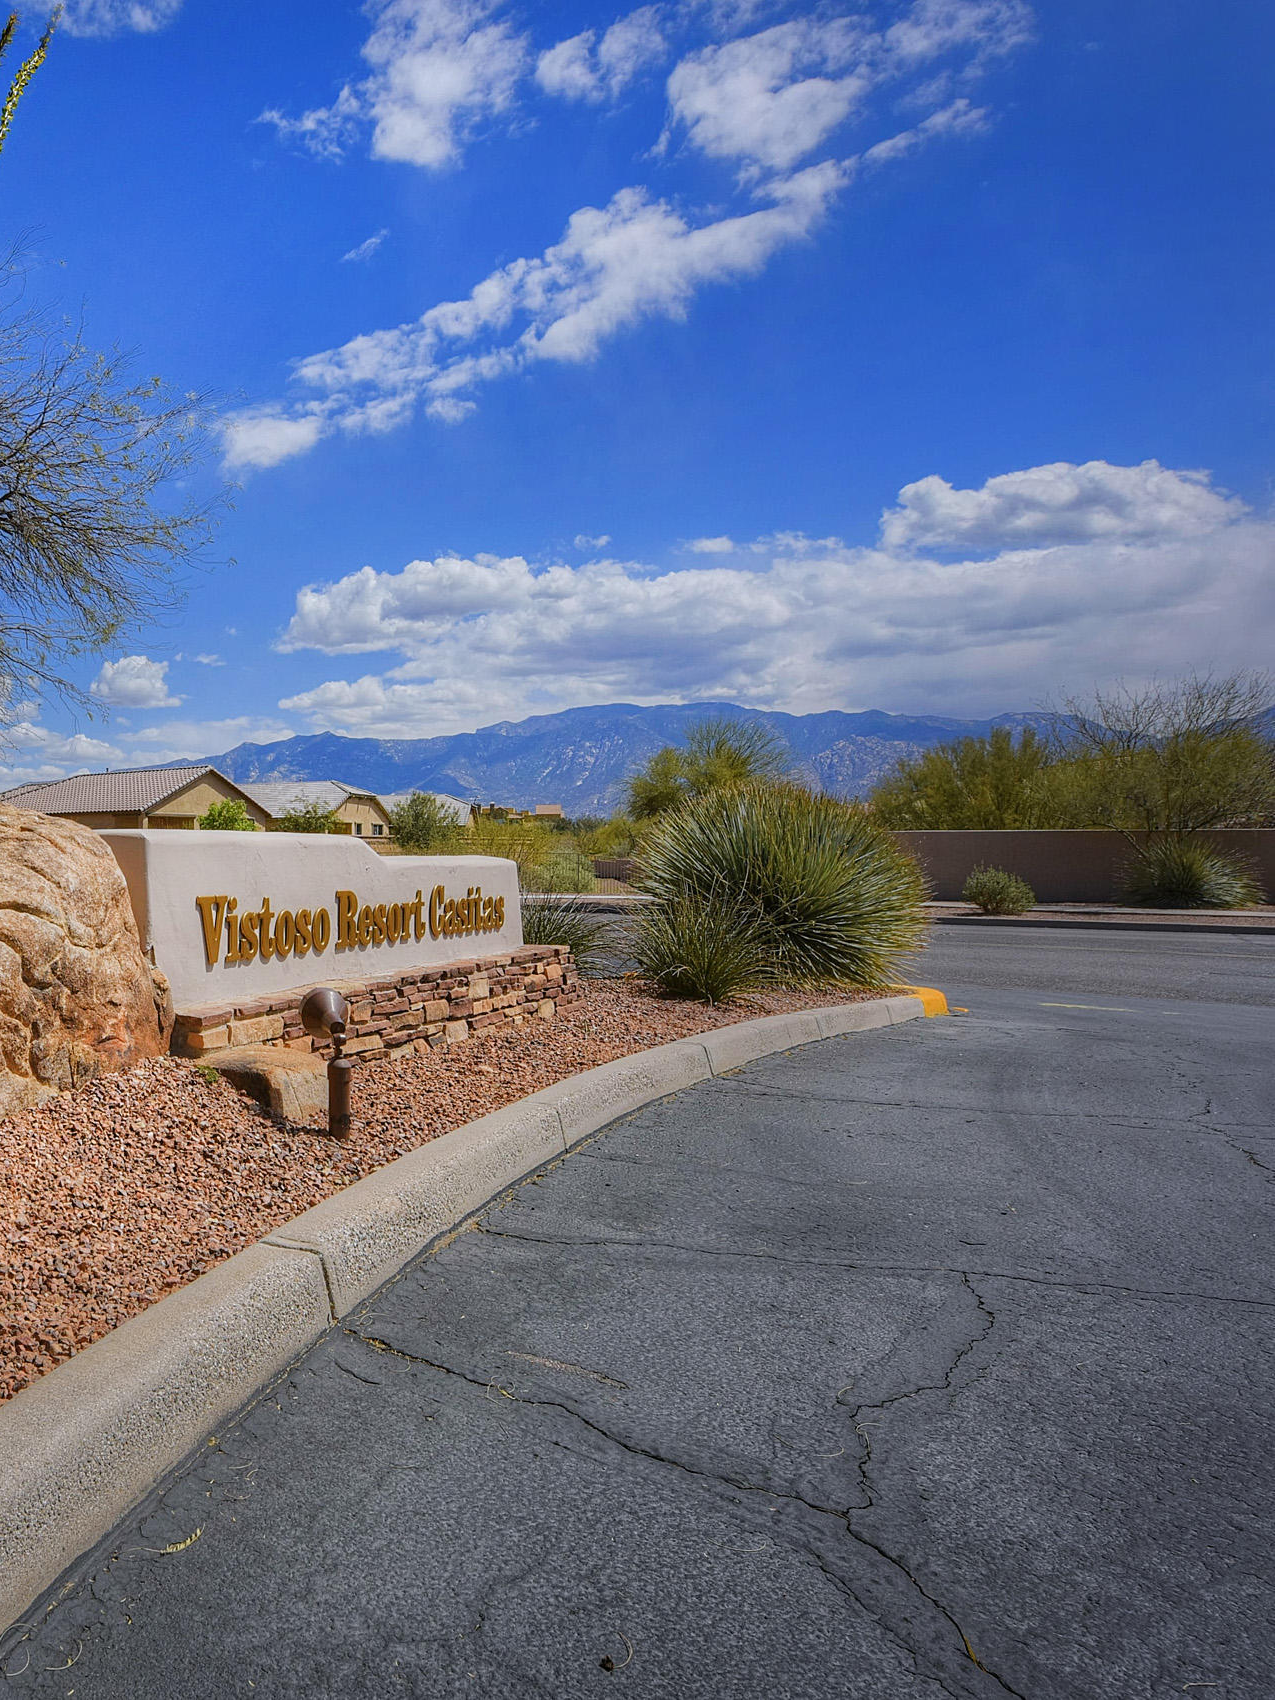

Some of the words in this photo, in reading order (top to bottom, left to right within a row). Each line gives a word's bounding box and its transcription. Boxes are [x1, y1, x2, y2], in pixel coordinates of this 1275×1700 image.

[196, 895, 330, 964] Vistoso
[335, 889, 426, 949] Resort
[429, 884, 505, 939] Casitas
